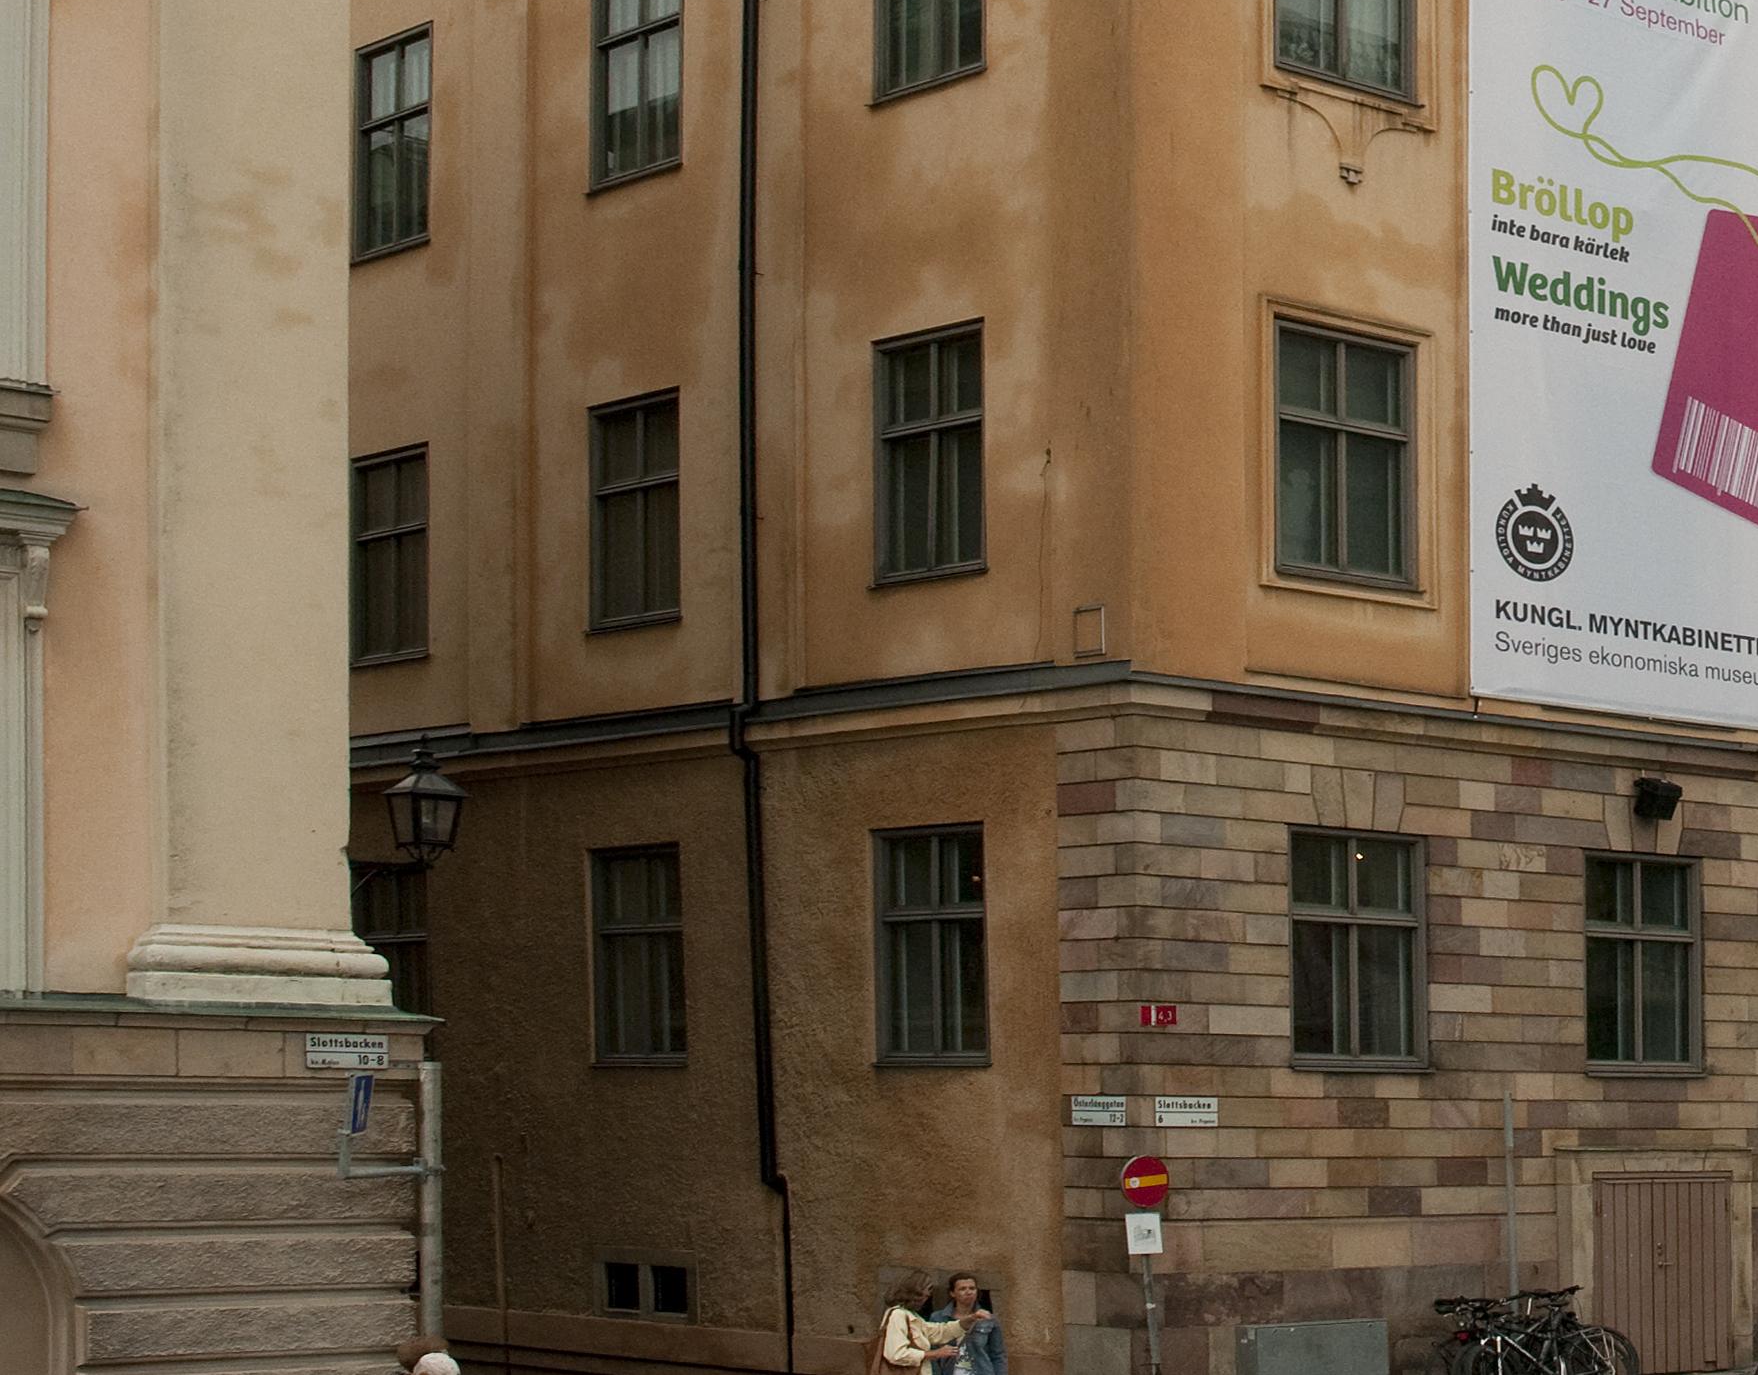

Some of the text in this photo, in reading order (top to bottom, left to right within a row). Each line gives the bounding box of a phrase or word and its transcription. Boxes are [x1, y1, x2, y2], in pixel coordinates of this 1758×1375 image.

[1492, 168, 1634, 243] Bröllop
[1491, 214, 1630, 263] inte bara kärlek
[1492, 255, 1670, 336] Weddings
[1494, 307, 1656, 353] more than just love
[1497, 504, 1573, 580] KUNGLIGA MYNTKABINETTET
[1495, 599, 1582, 631] KUNGL.
[1495, 631, 1582, 664] Sveriges
[1589, 646, 1699, 677] ekonomiska
[310, 1037, 384, 1048] Slottsbacken
[358, 1054, 384, 1065] 10-8
[1158, 1100, 1211, 1109] Slottsbacken
